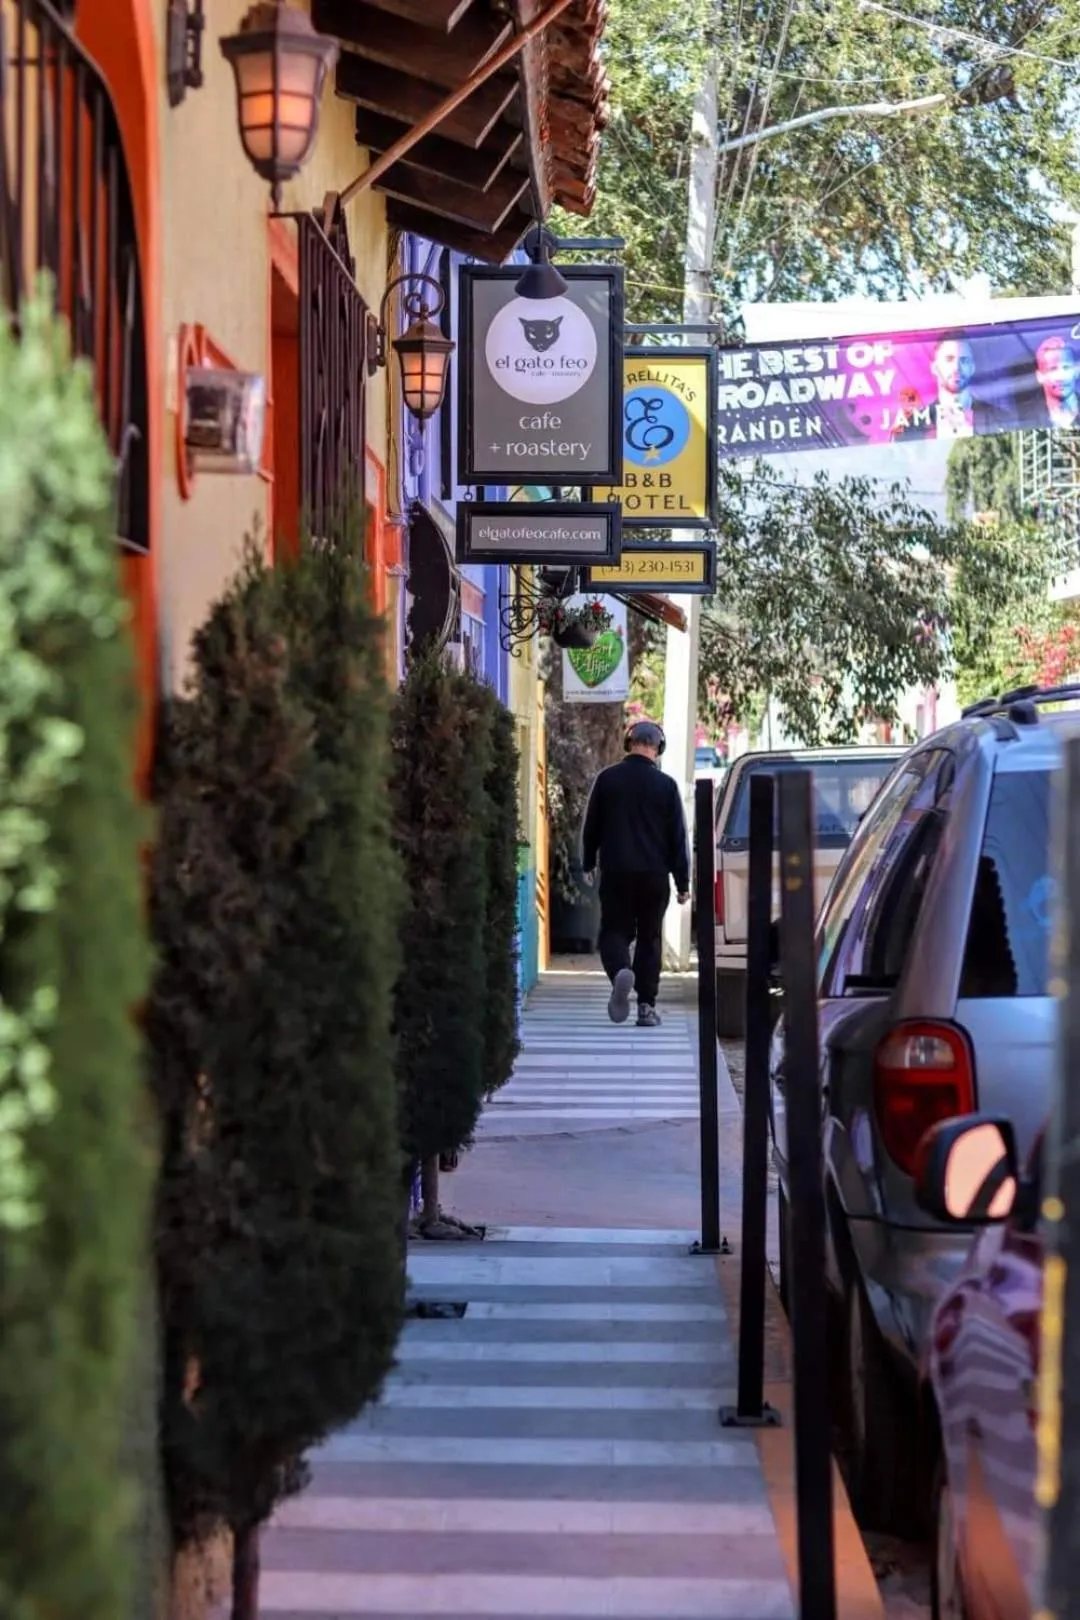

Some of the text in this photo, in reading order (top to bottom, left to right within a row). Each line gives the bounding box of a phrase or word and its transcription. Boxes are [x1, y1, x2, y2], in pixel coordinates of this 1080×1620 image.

[495, 354, 588, 373] el gato feo
[759, 345, 840, 376] BEST
[847, 342, 895, 367] OF
[519, 412, 561, 430] cafe
[506, 440, 591, 460] roastery
[625, 473, 672, 488] B & B
[614, 494, 691, 510] OTEL
[479, 526, 600, 541] elgatofeocafe.com
[638, 560, 695, 574] 230-1531
